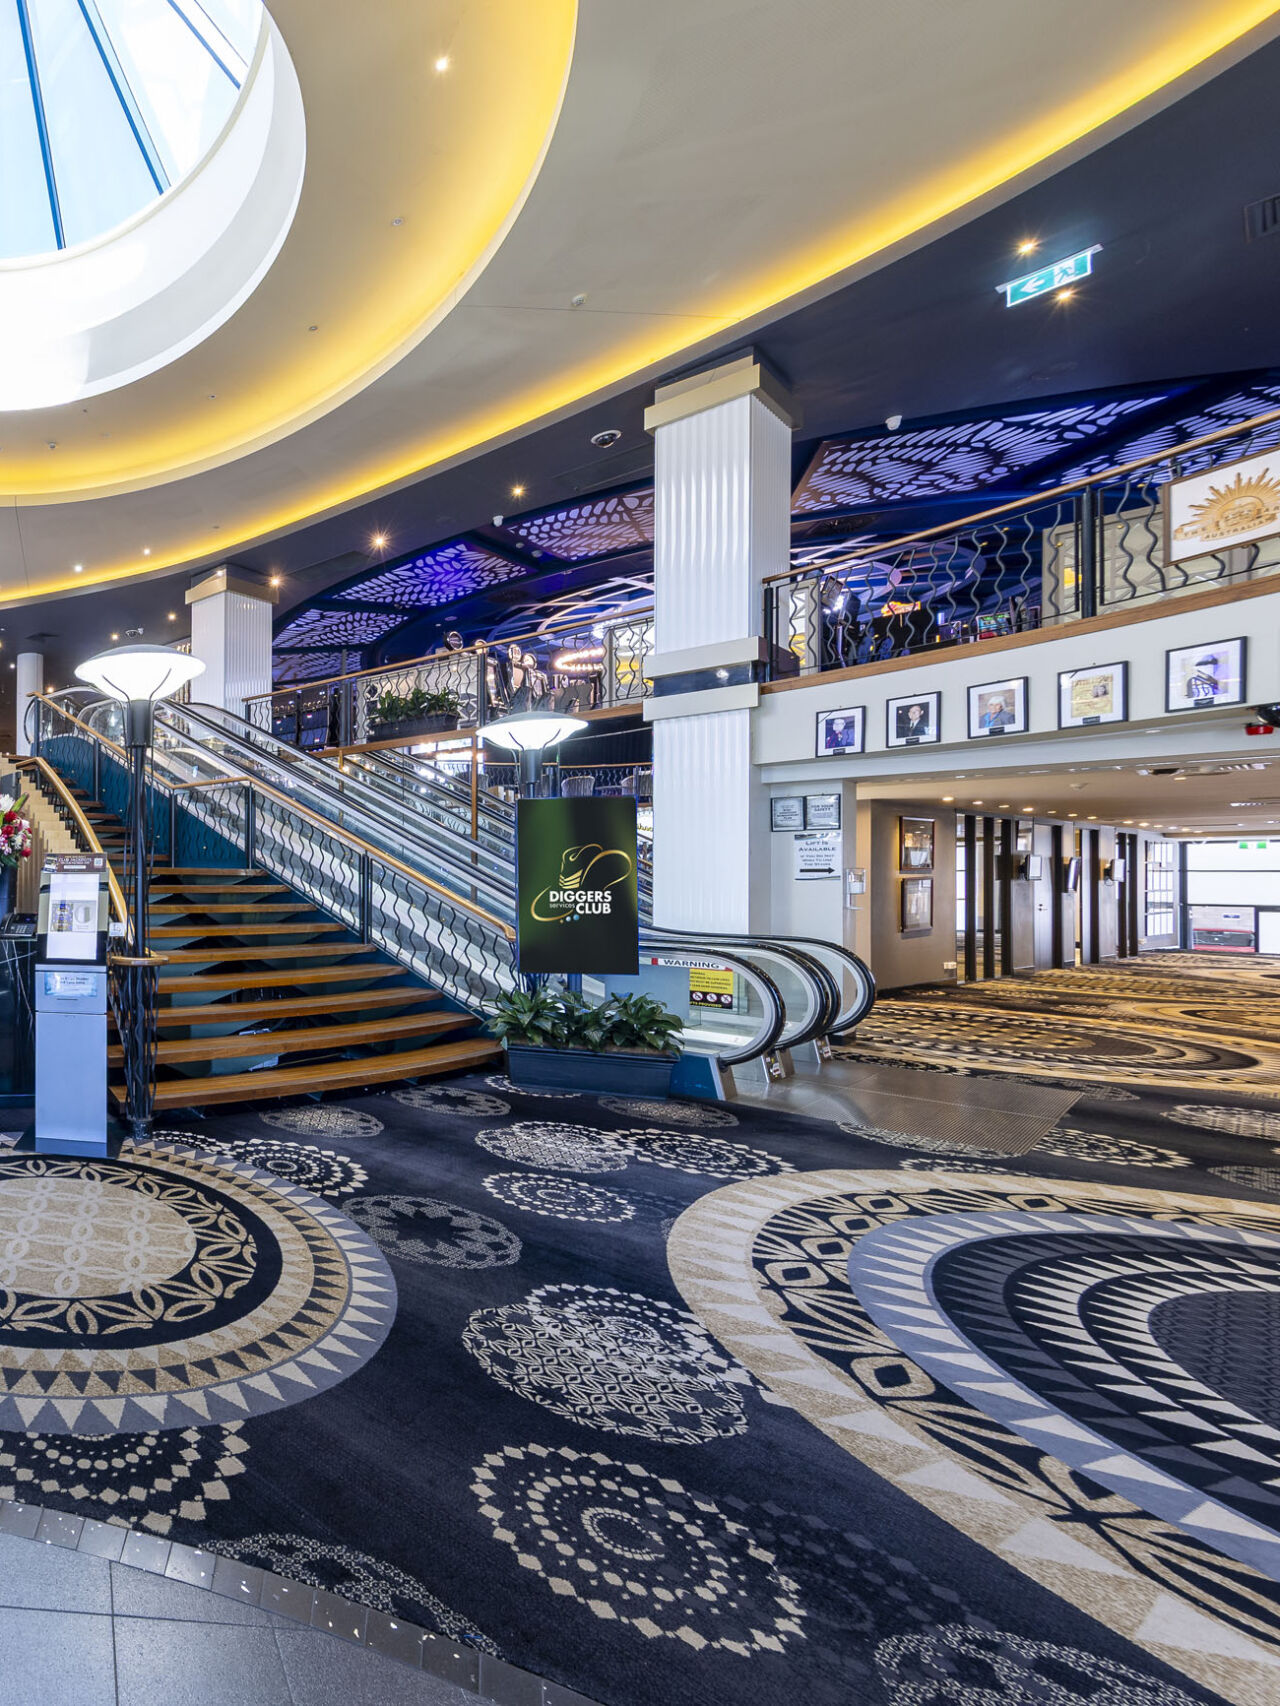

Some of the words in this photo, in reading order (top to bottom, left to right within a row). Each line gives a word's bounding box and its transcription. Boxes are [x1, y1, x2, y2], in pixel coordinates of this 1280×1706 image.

[549, 891, 612, 902] DIGGERS
[575, 902, 611, 914] CLUB
[663, 959, 719, 968] WARNING
